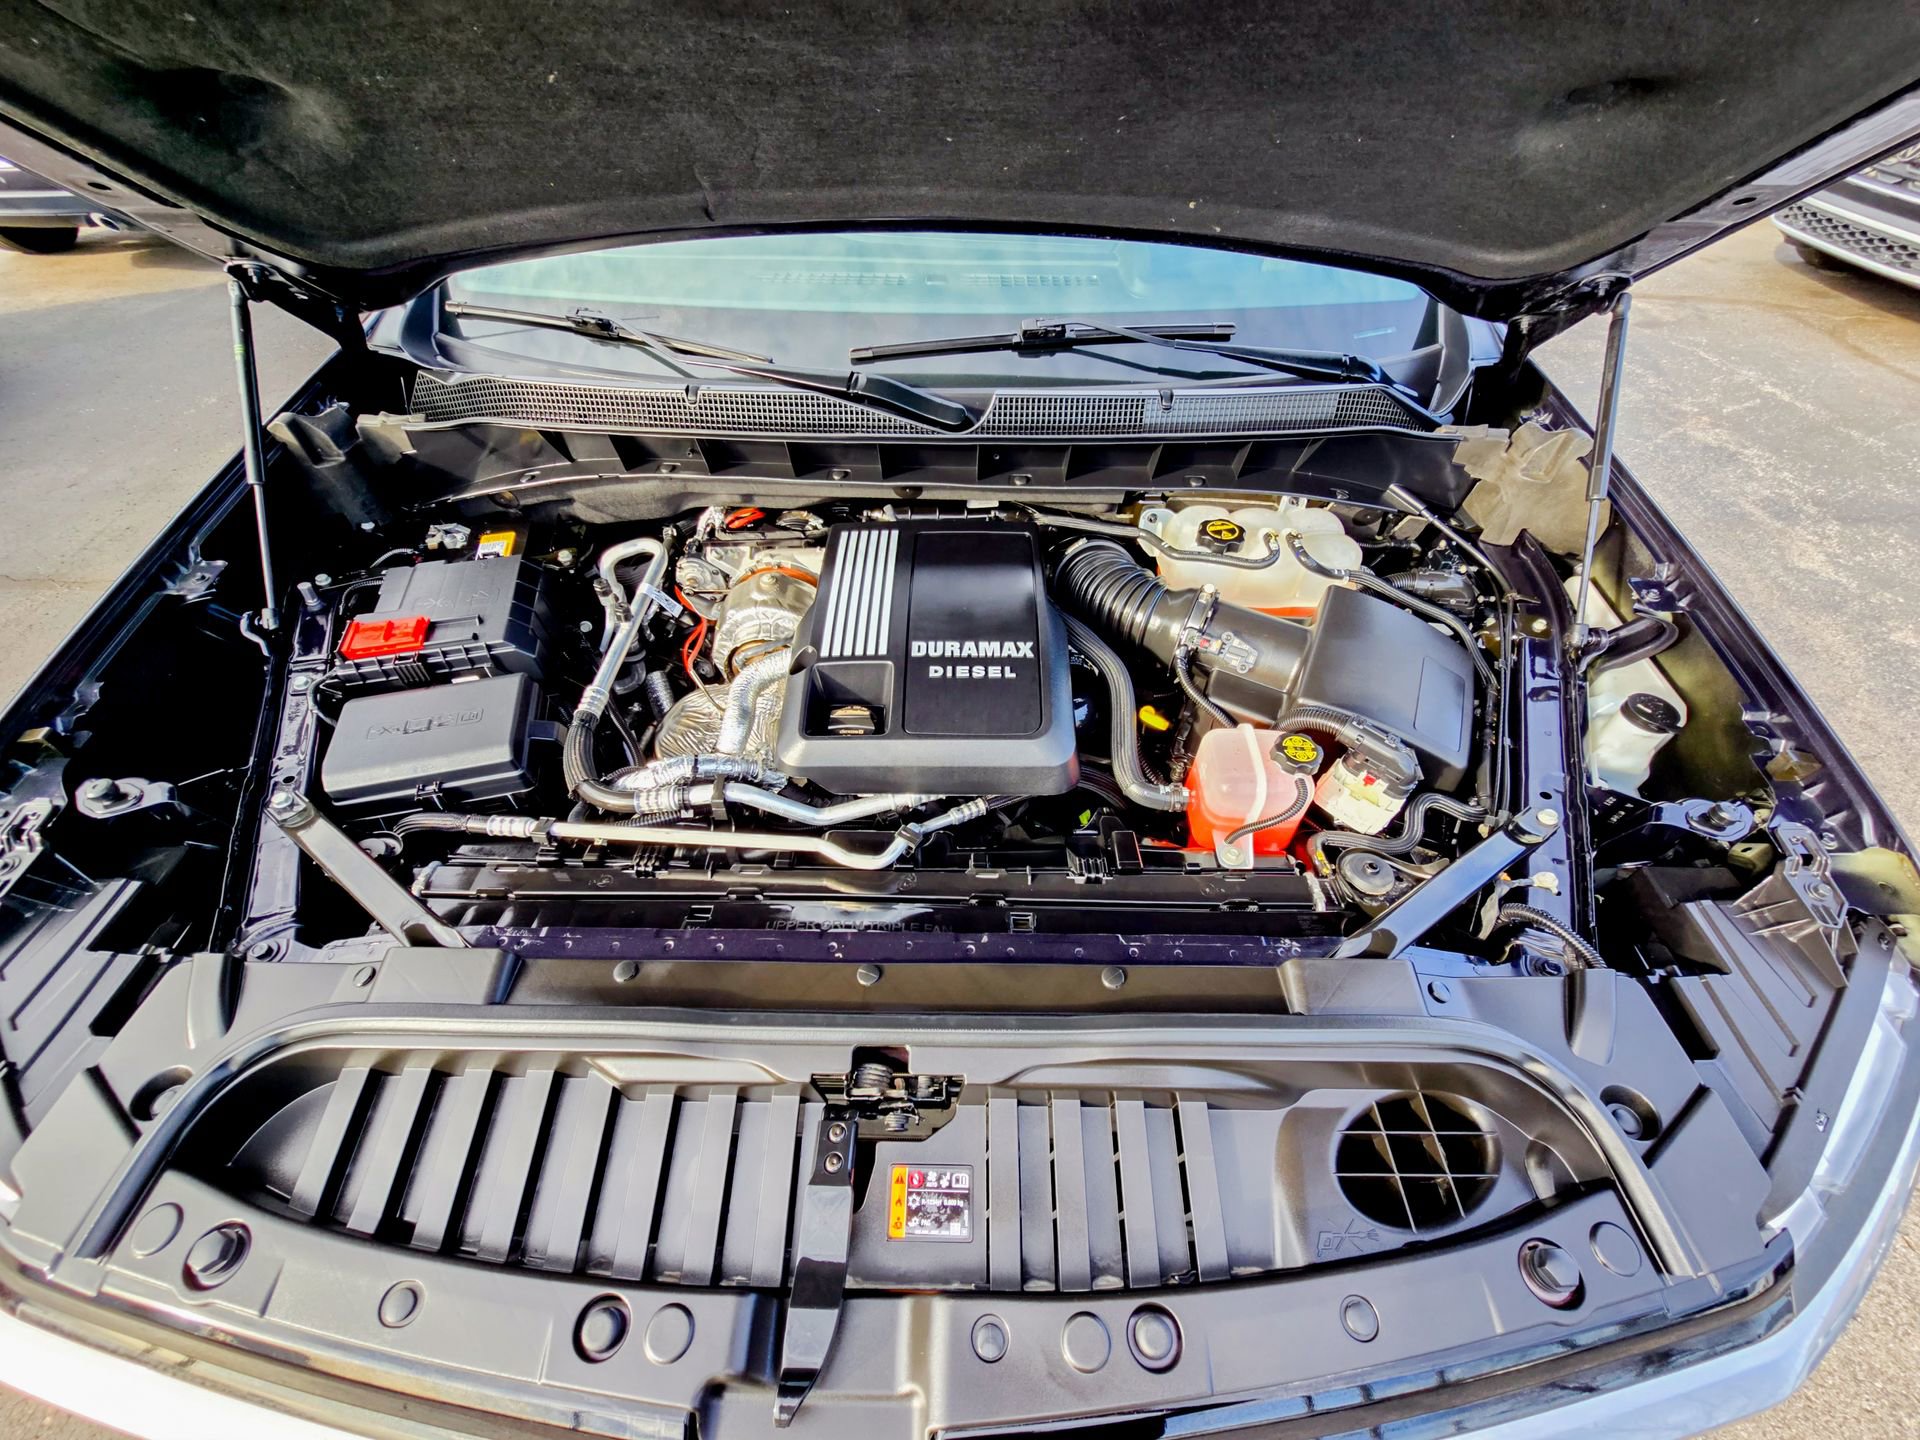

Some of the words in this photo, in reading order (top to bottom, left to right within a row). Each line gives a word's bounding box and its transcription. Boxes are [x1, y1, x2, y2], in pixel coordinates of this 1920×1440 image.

[911, 641, 1034, 658] DURAMAX
[928, 665, 1017, 679] DIESEL
[766, 920, 816, 931] UPPER
[868, 920, 920, 932] TRIPLE
[924, 923, 953, 933] FAN
